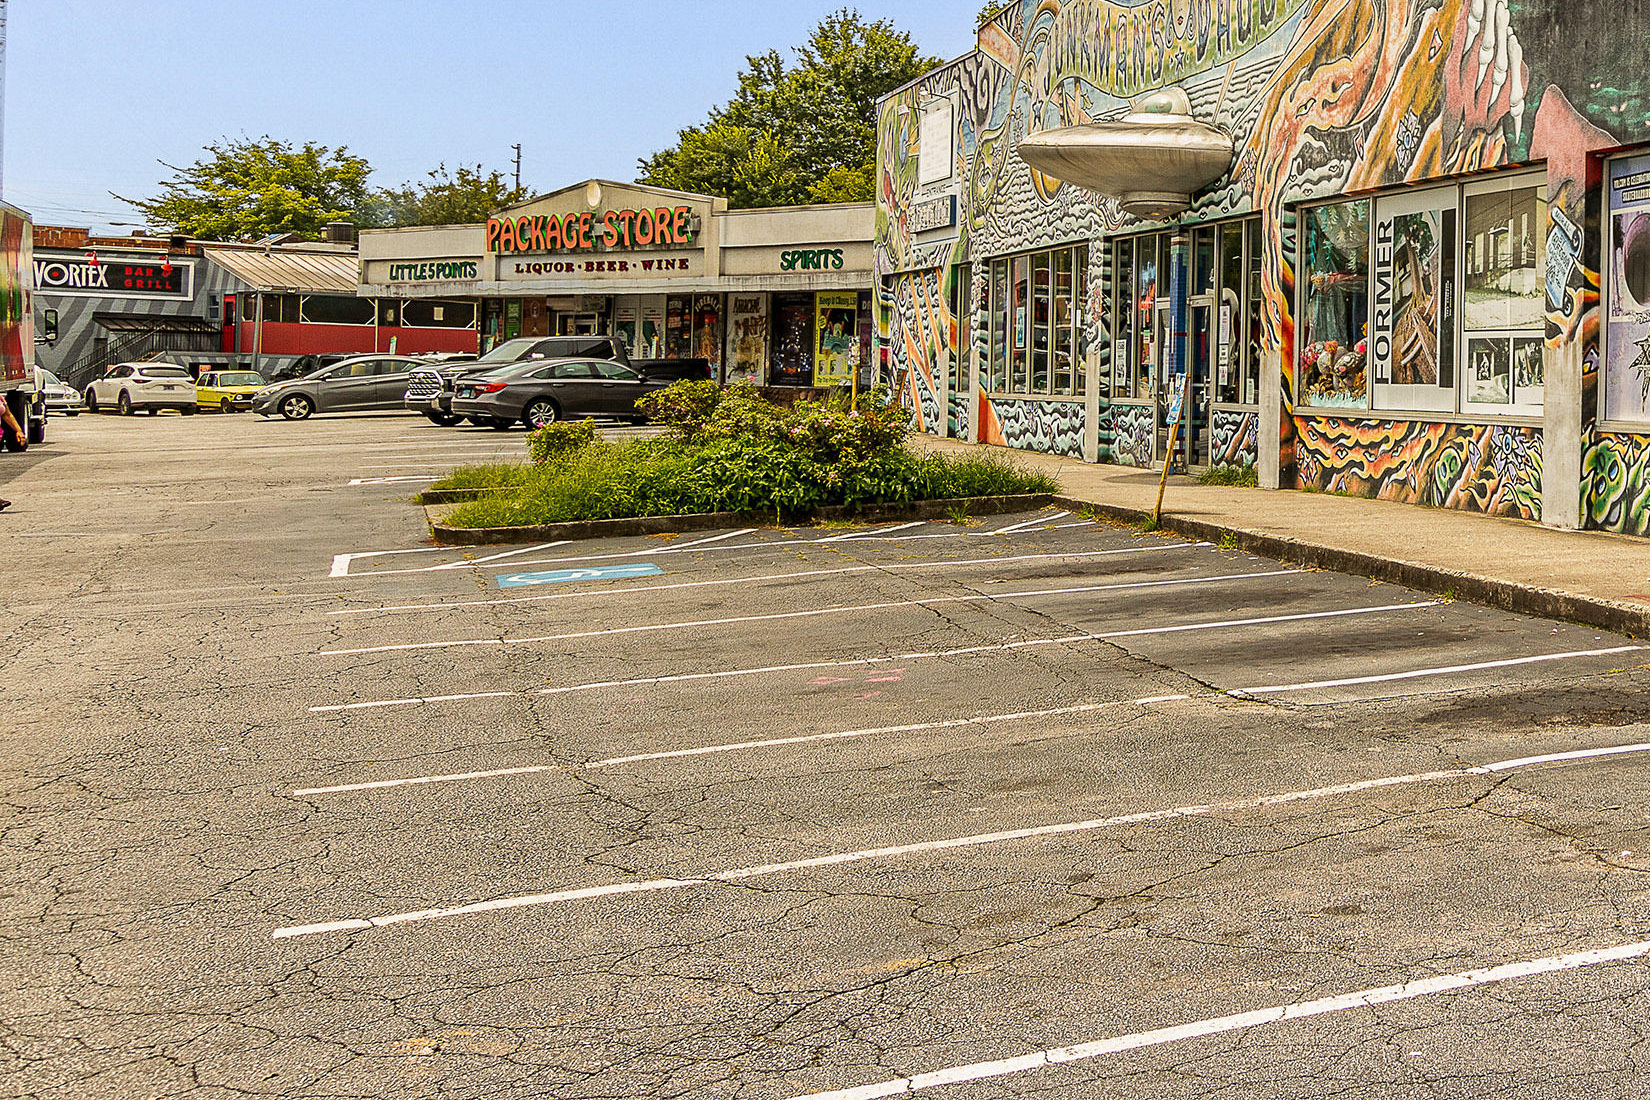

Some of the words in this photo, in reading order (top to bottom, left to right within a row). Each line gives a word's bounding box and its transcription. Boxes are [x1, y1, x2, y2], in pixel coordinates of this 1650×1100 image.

[486, 212, 596, 251] PACKAGE
[603, 205, 692, 247] STORE
[515, 262, 574, 275] LIQUOR
[584, 260, 628, 273] BEER
[641, 258, 689, 271] WINE
[780, 249, 844, 271] SPIRITS
[33, 260, 109, 291] VORTEX
[125, 267, 153, 277] BAR
[389, 263, 428, 280] LITTLE
[428, 263, 436, 279] 5
[436, 261, 477, 279] POINTS
[124, 278, 172, 289] GRILL
[1374, 218, 1393, 386] FORMER
